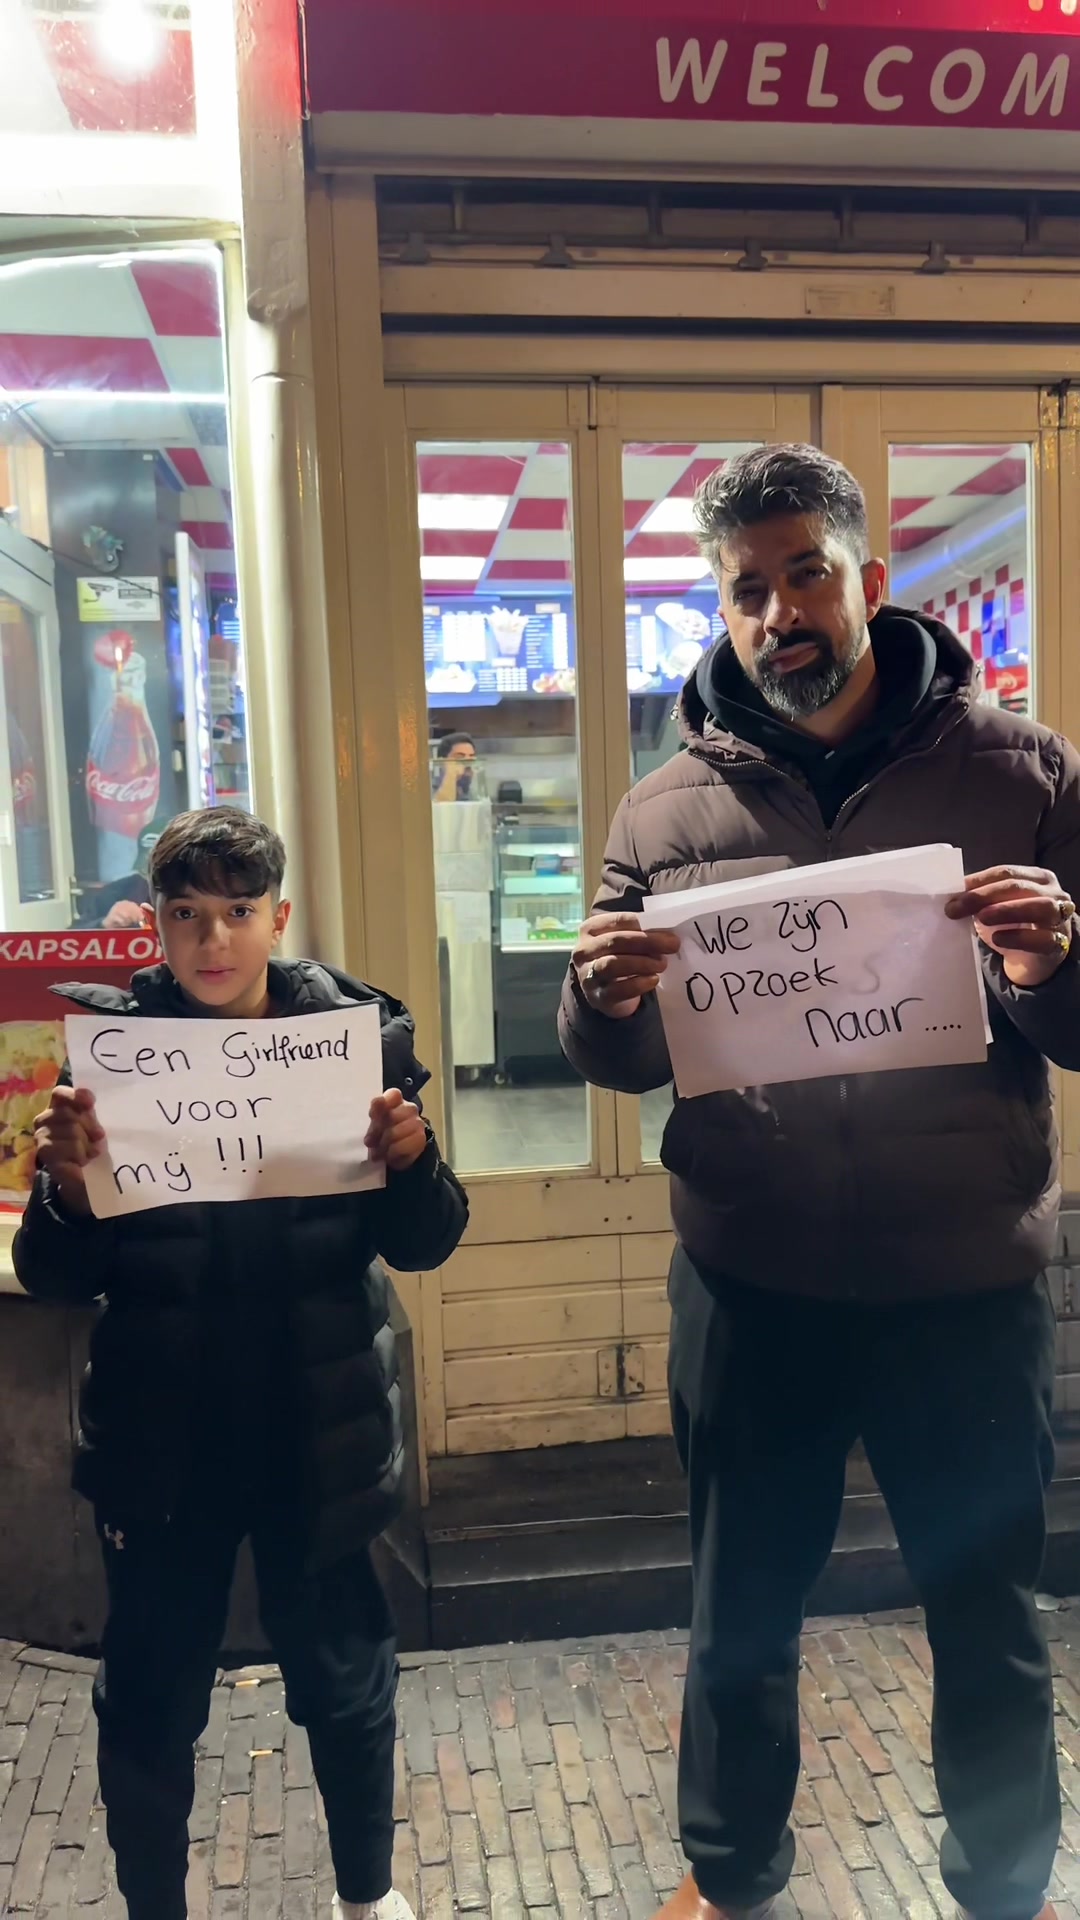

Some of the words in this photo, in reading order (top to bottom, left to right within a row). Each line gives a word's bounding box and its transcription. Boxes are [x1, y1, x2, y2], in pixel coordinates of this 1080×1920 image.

[694, 914, 753, 955] We
[90, 1028, 191, 1076] Een
[221, 1029, 350, 1078] Girlfriend
[155, 1097, 273, 1126] voor
